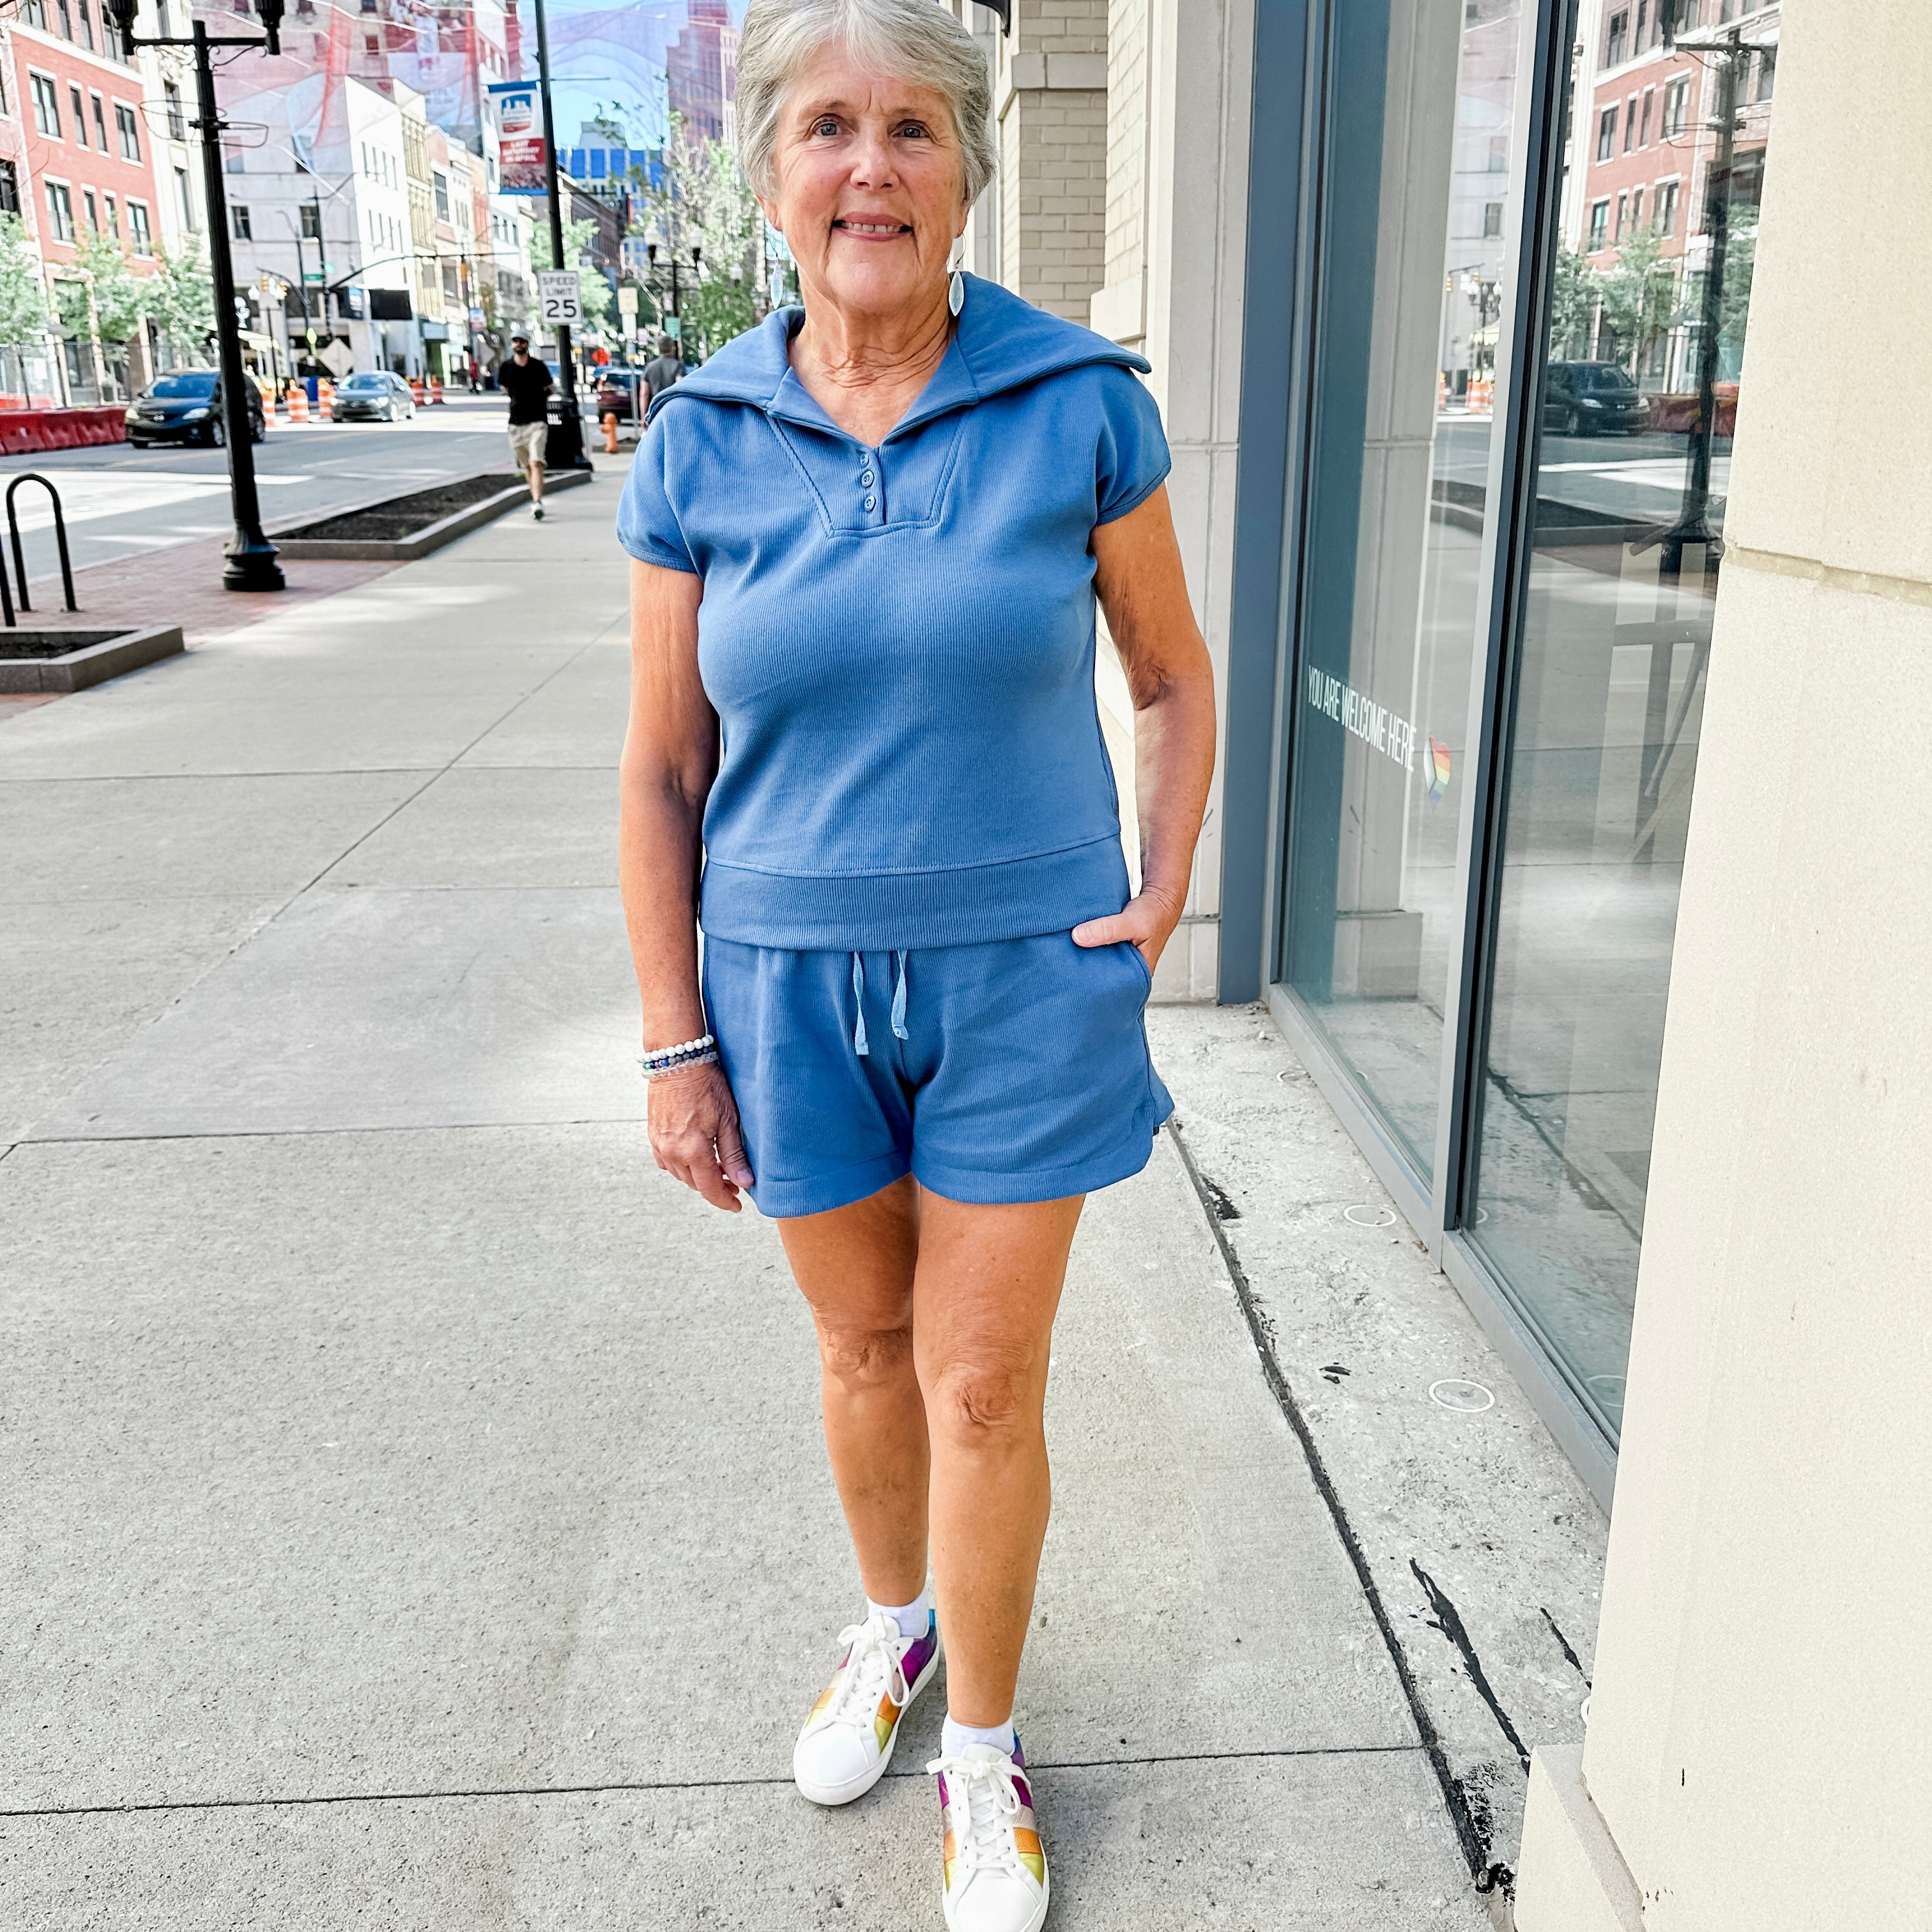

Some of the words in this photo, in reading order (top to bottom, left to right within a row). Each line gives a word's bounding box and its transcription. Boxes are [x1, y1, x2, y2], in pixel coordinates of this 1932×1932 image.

[542, 277, 576, 286] SPEED
[546, 288, 572, 296] LIMIT
[546, 299, 577, 318] 25
[1308, 664, 1324, 710] YOU
[1322, 675, 1341, 722] ARE
[1342, 684, 1388, 753] WELCOME
[1387, 712, 1417, 772] HERE
